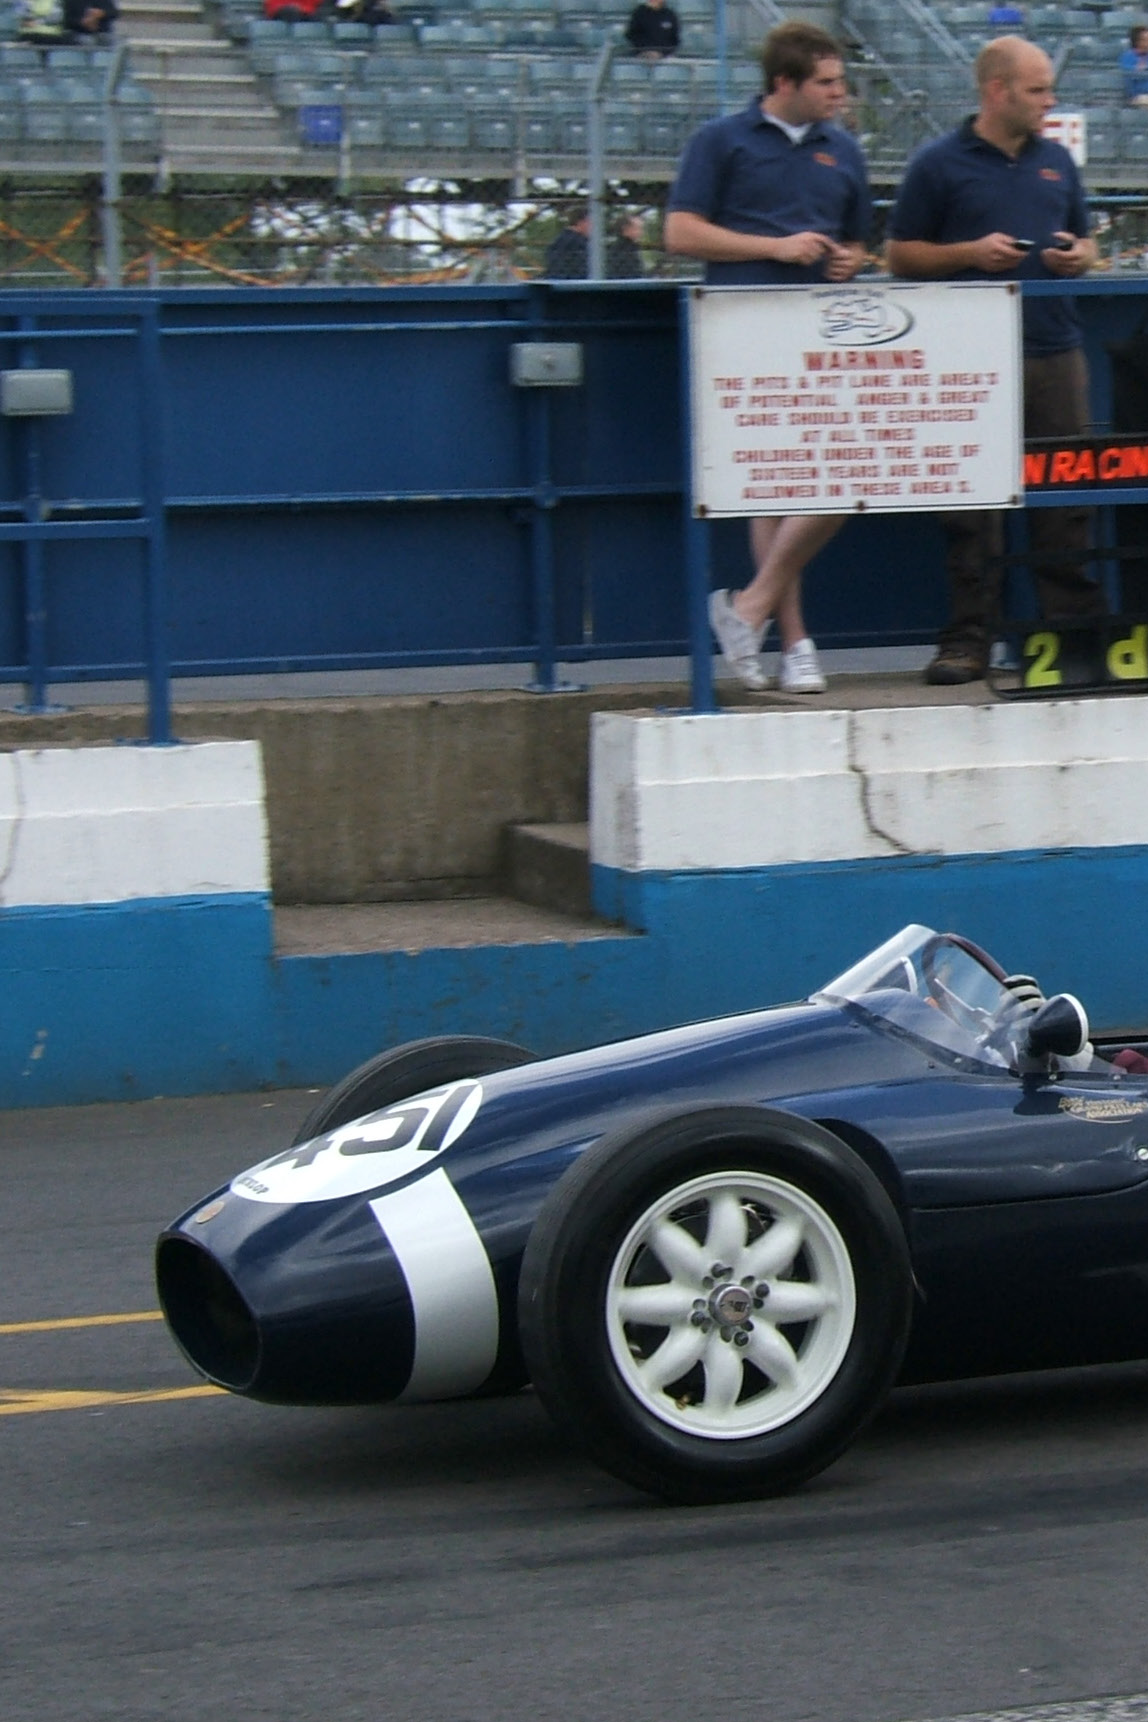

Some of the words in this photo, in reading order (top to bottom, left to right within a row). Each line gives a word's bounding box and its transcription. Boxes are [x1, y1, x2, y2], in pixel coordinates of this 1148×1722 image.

[803, 349, 926, 372] WARNING
[713, 377, 745, 391] THE
[752, 376, 790, 389] PITS
[797, 378, 809, 389] &
[817, 375, 843, 388] PIT
[850, 374, 892, 388] LANE
[899, 374, 930, 387] ARE
[720, 396, 740, 409] OF
[748, 394, 837, 409] POTENTIAL
[919, 393, 930, 405] &
[938, 391, 989, 404] GREAT
[735, 413, 780, 428] CARE
[788, 411, 853, 426] SHOULD
[859, 411, 878, 424] BE
[887, 409, 977, 424] EXERCISED
[801, 431, 820, 443] AT
[828, 430, 856, 442] ALL
[866, 428, 916, 441] TIMES
[733, 448, 816, 463] CHILDREN
[823, 446, 878, 461] UNDER
[885, 445, 914, 459] THE
[922, 445, 952, 458] AGE
[960, 444, 981, 457] OF
[750, 466, 820, 481] SIXTEEN
[826, 465, 879, 478] YEARS
[889, 464, 920, 476] ARE
[927, 462, 958, 476] NOT
[742, 484, 819, 500] ALLOWED
[826, 484, 845, 496] IN
[852, 483, 901, 496] THESE
[1024, 632, 1062, 687] 2
